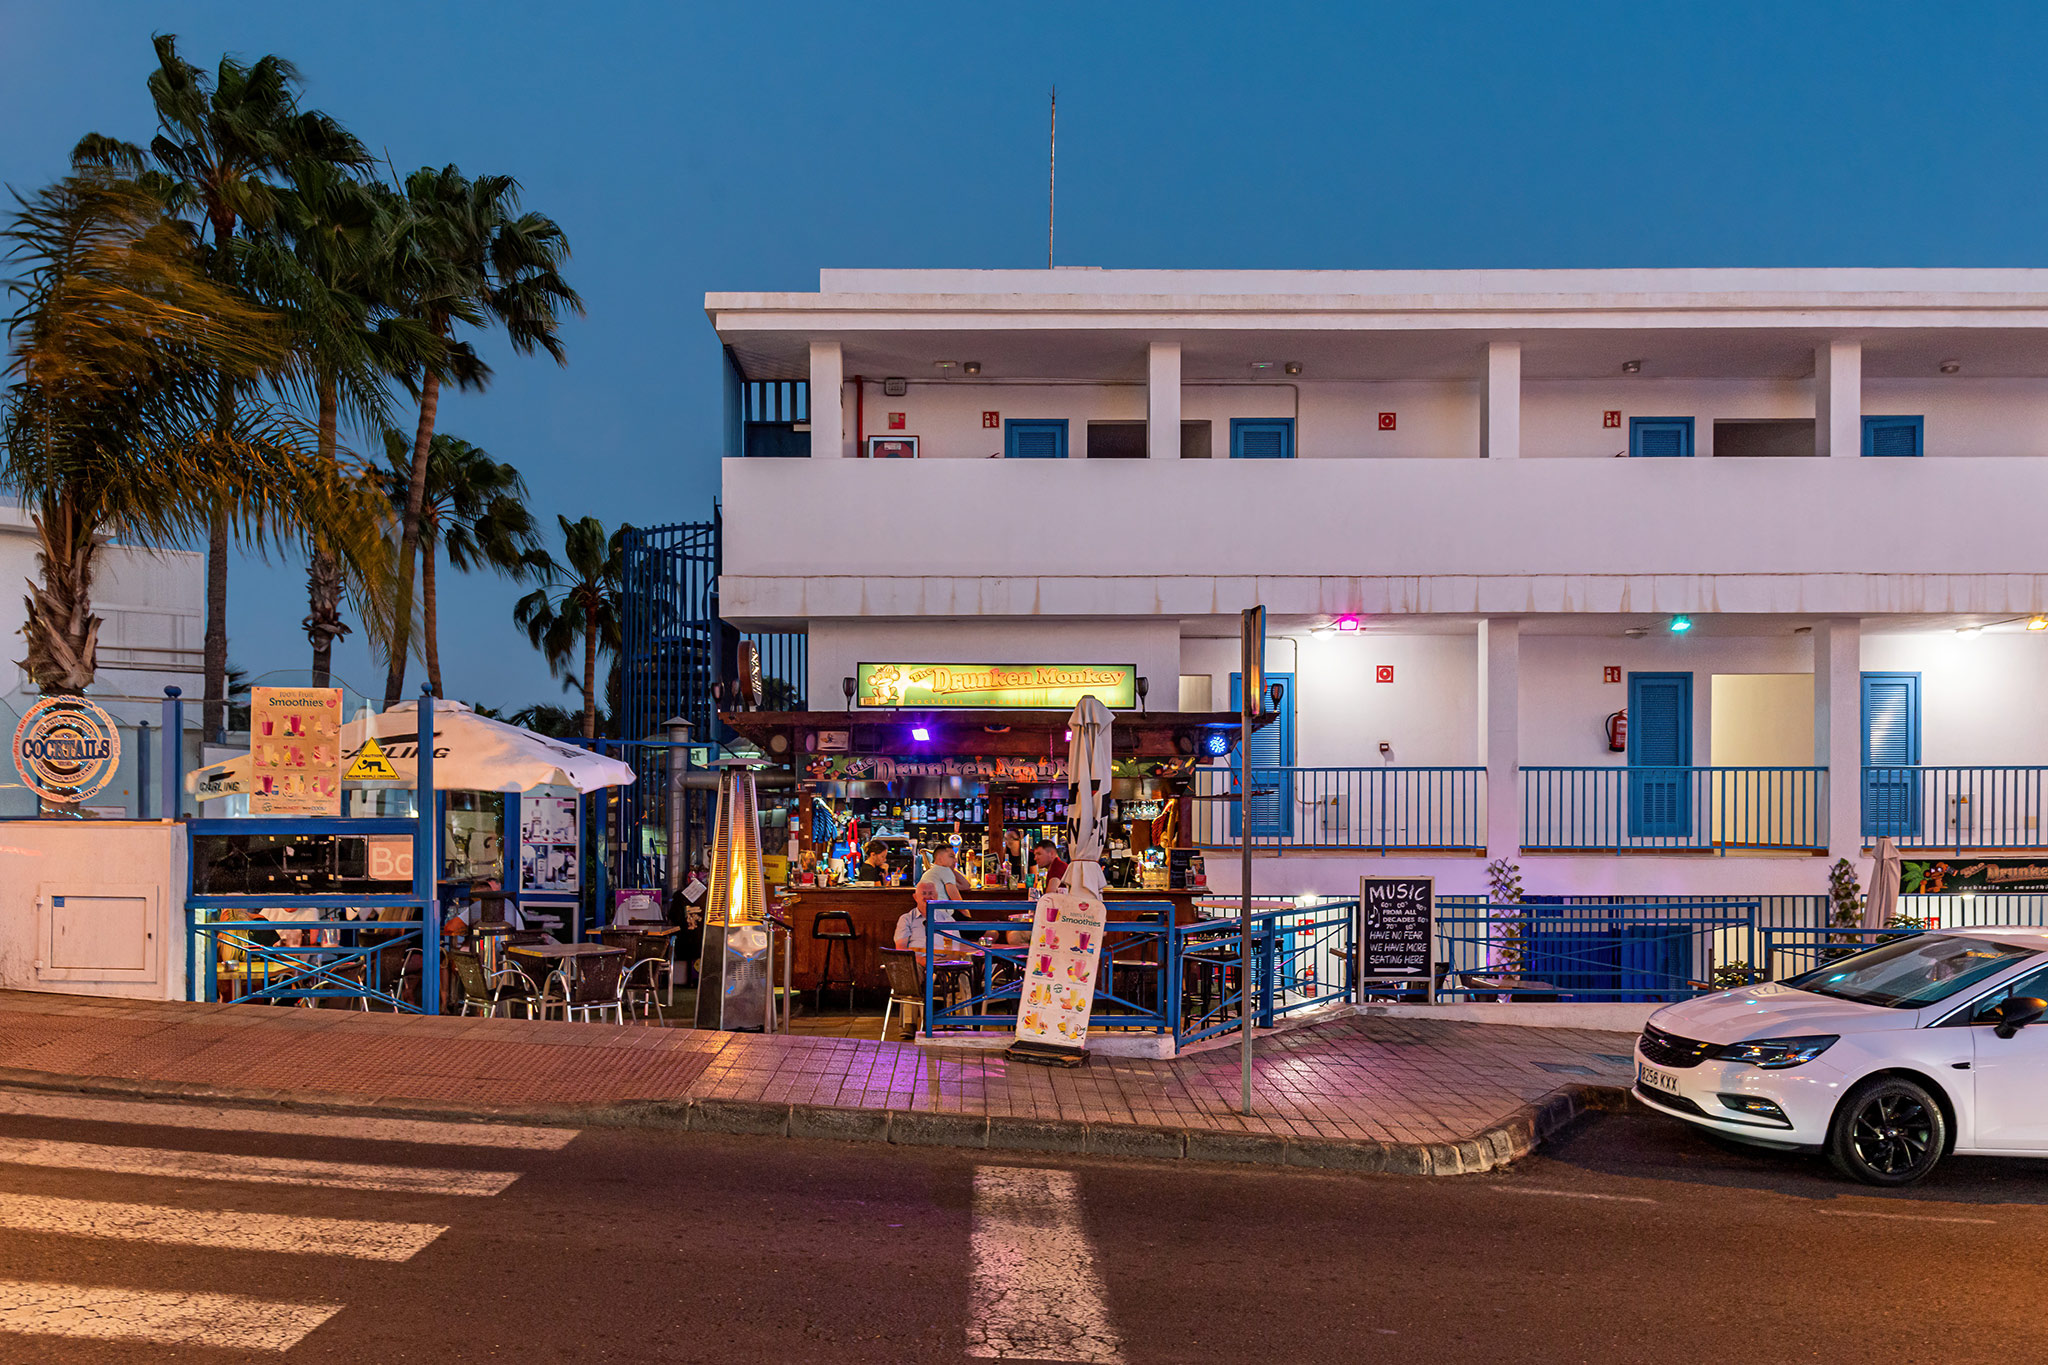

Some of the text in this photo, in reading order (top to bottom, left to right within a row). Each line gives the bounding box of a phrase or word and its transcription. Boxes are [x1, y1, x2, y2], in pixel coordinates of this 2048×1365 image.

[909, 667, 1126, 692] The Drunken Monkey
[269, 697, 323, 707] Smoothies
[23, 740, 110, 759] COCKTAILS
[846, 758, 875, 776] The
[873, 757, 993, 781] Drunken
[1369, 883, 1426, 903] MUSIC
[1061, 915, 1101, 927] Smoothies
[1370, 931, 1424, 940] HAVE NO FEAR
[1370, 943, 1428, 952] WE HAVE MORE
[1370, 955, 1424, 963] SEATING HERE
